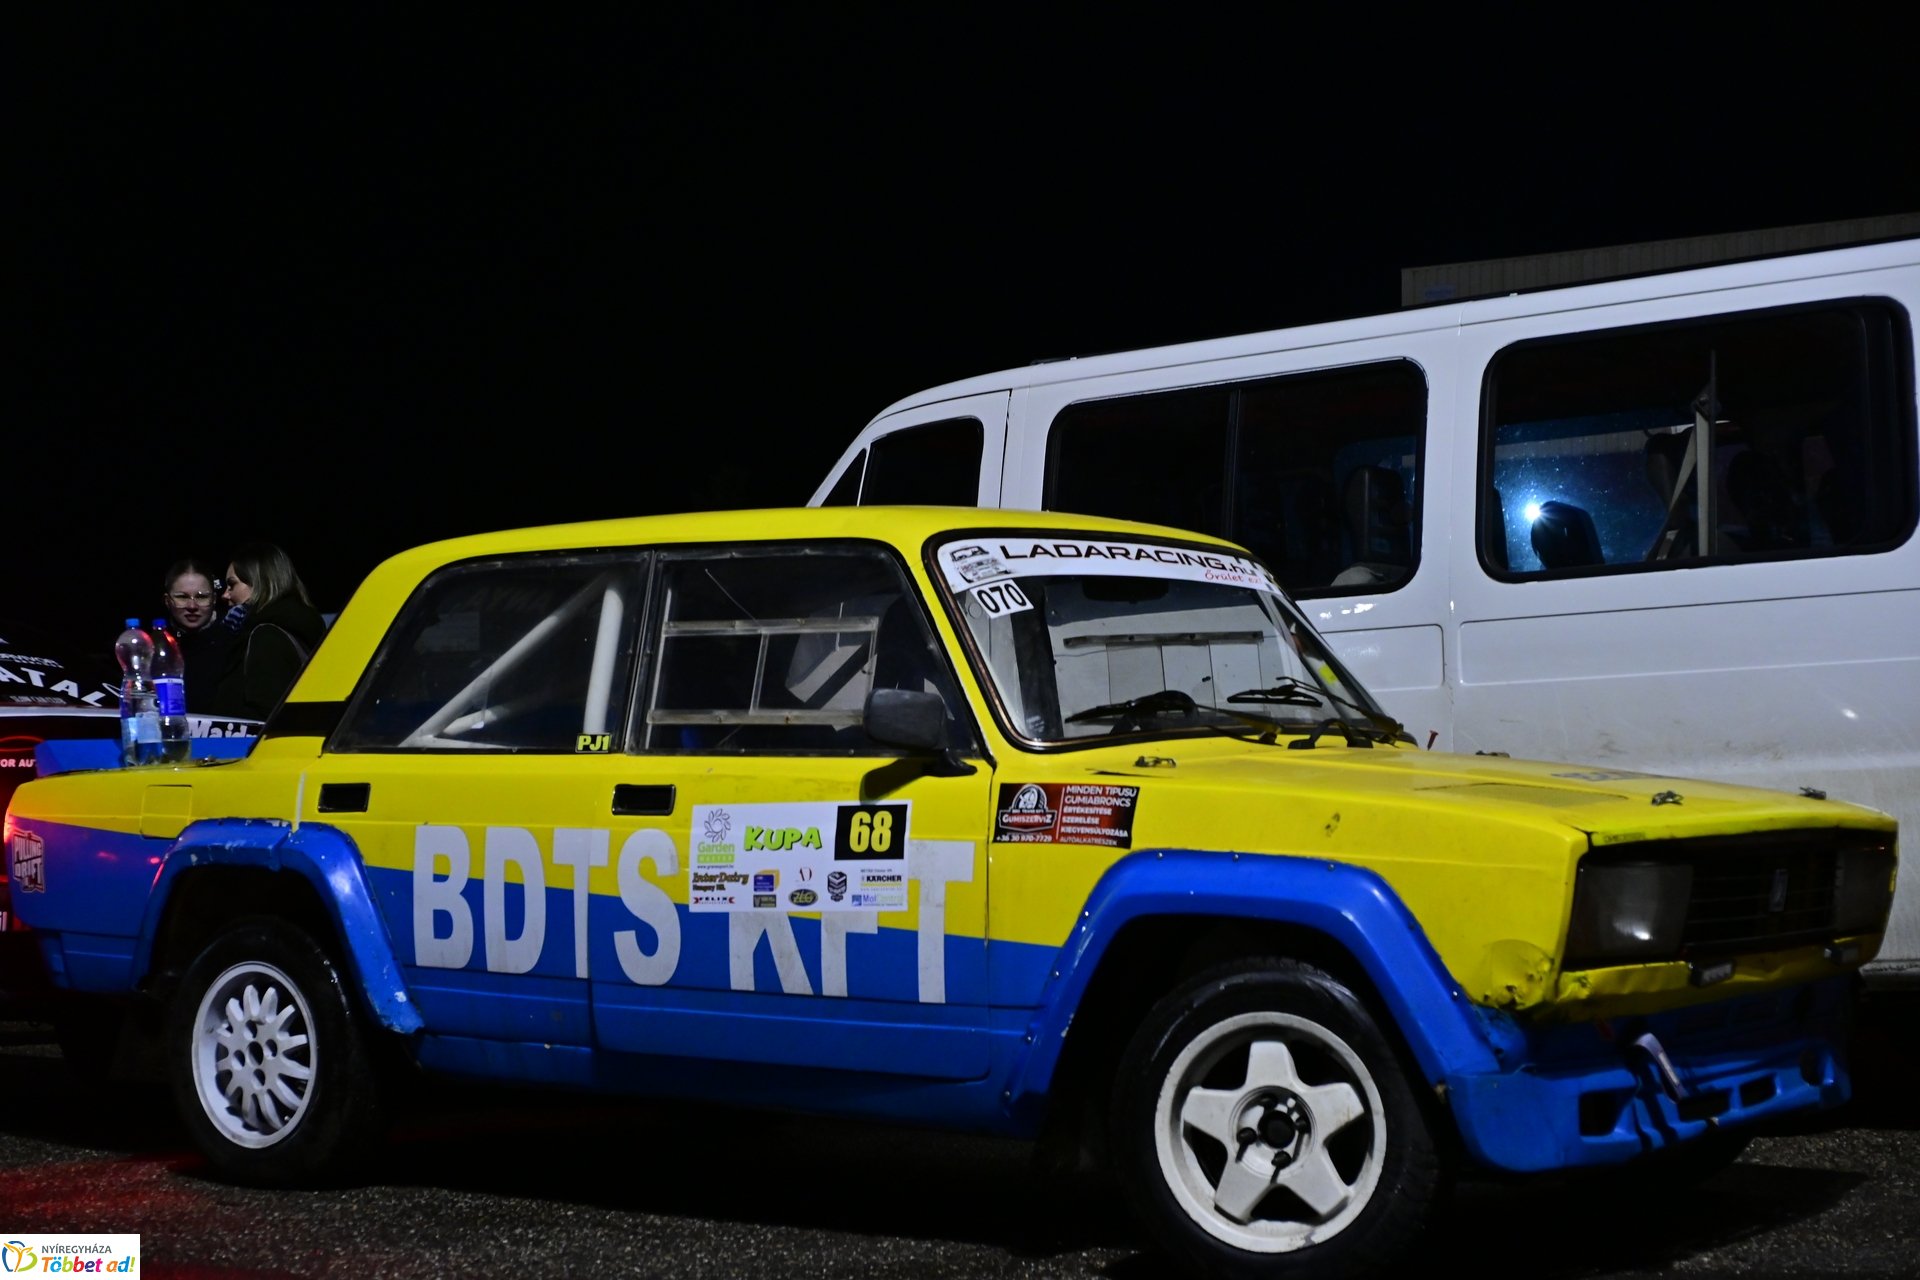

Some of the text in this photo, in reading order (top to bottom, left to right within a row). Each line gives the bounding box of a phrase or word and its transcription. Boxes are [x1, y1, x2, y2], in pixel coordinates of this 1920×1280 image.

[977, 584, 1027, 613] 070
[577, 735, 610, 751] PJ1
[1066, 785, 1103, 795] MINDEN
[1065, 796, 1131, 807] GUMIABRONCS
[744, 825, 823, 851] KUPA
[849, 810, 893, 853] 68
[697, 842, 735, 853] Garden
[413, 825, 682, 986] BDTS
